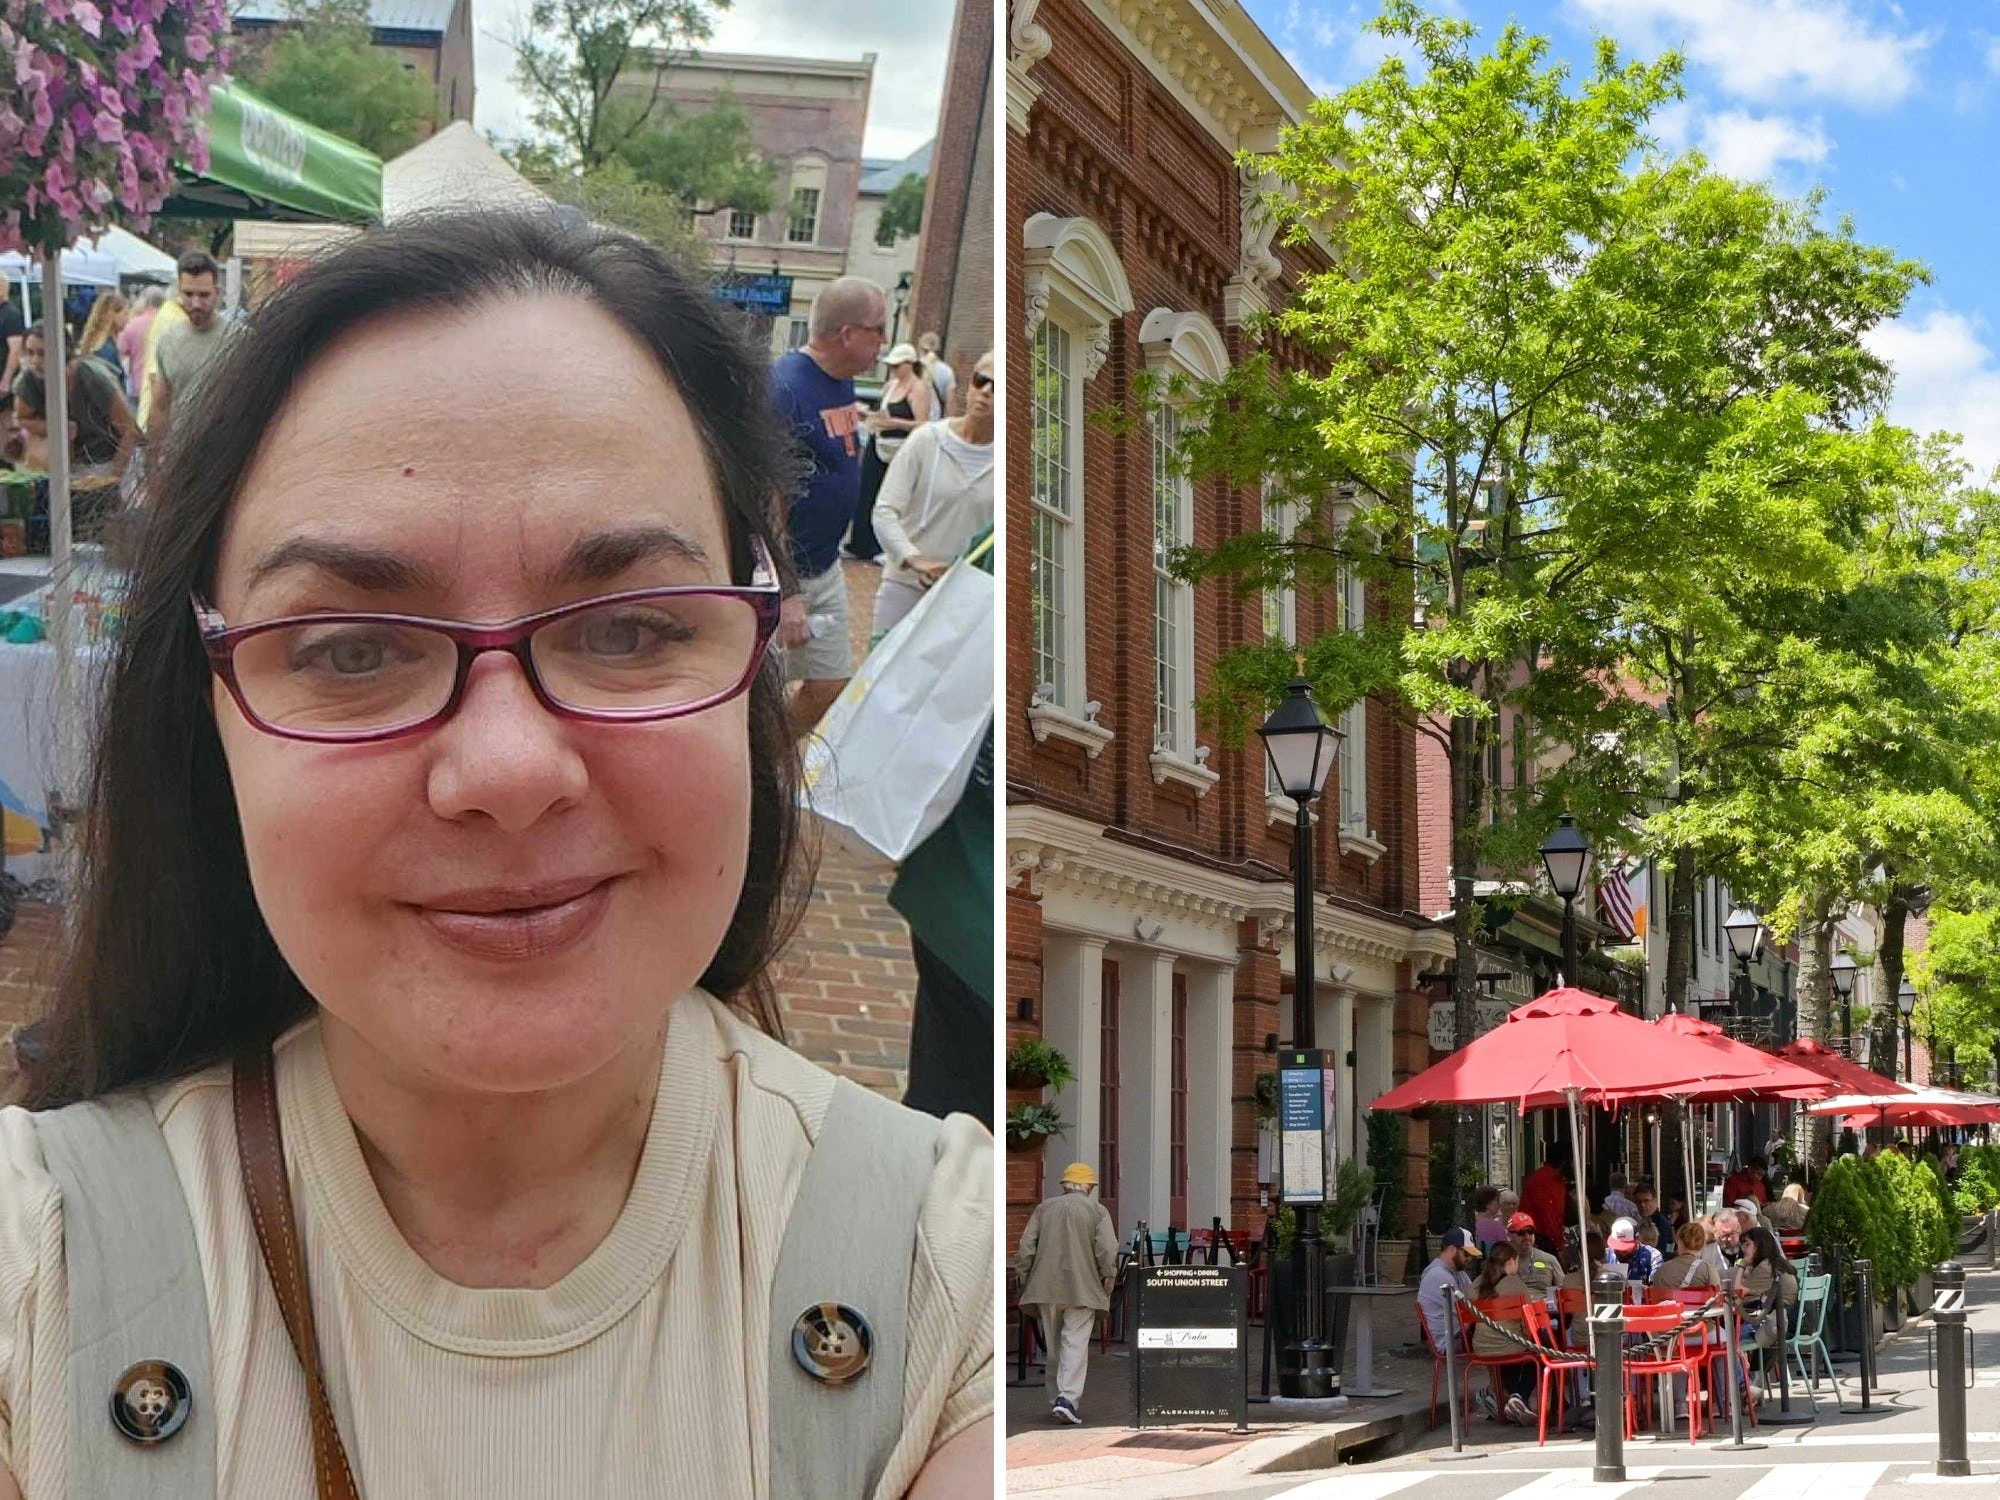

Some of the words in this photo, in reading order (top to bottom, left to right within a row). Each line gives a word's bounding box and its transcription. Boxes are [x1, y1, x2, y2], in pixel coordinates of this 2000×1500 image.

[1146, 1278, 1173, 1287] SOUTH
[1174, 1278, 1200, 1287] UNION
[1201, 1278, 1229, 1287] STREET
